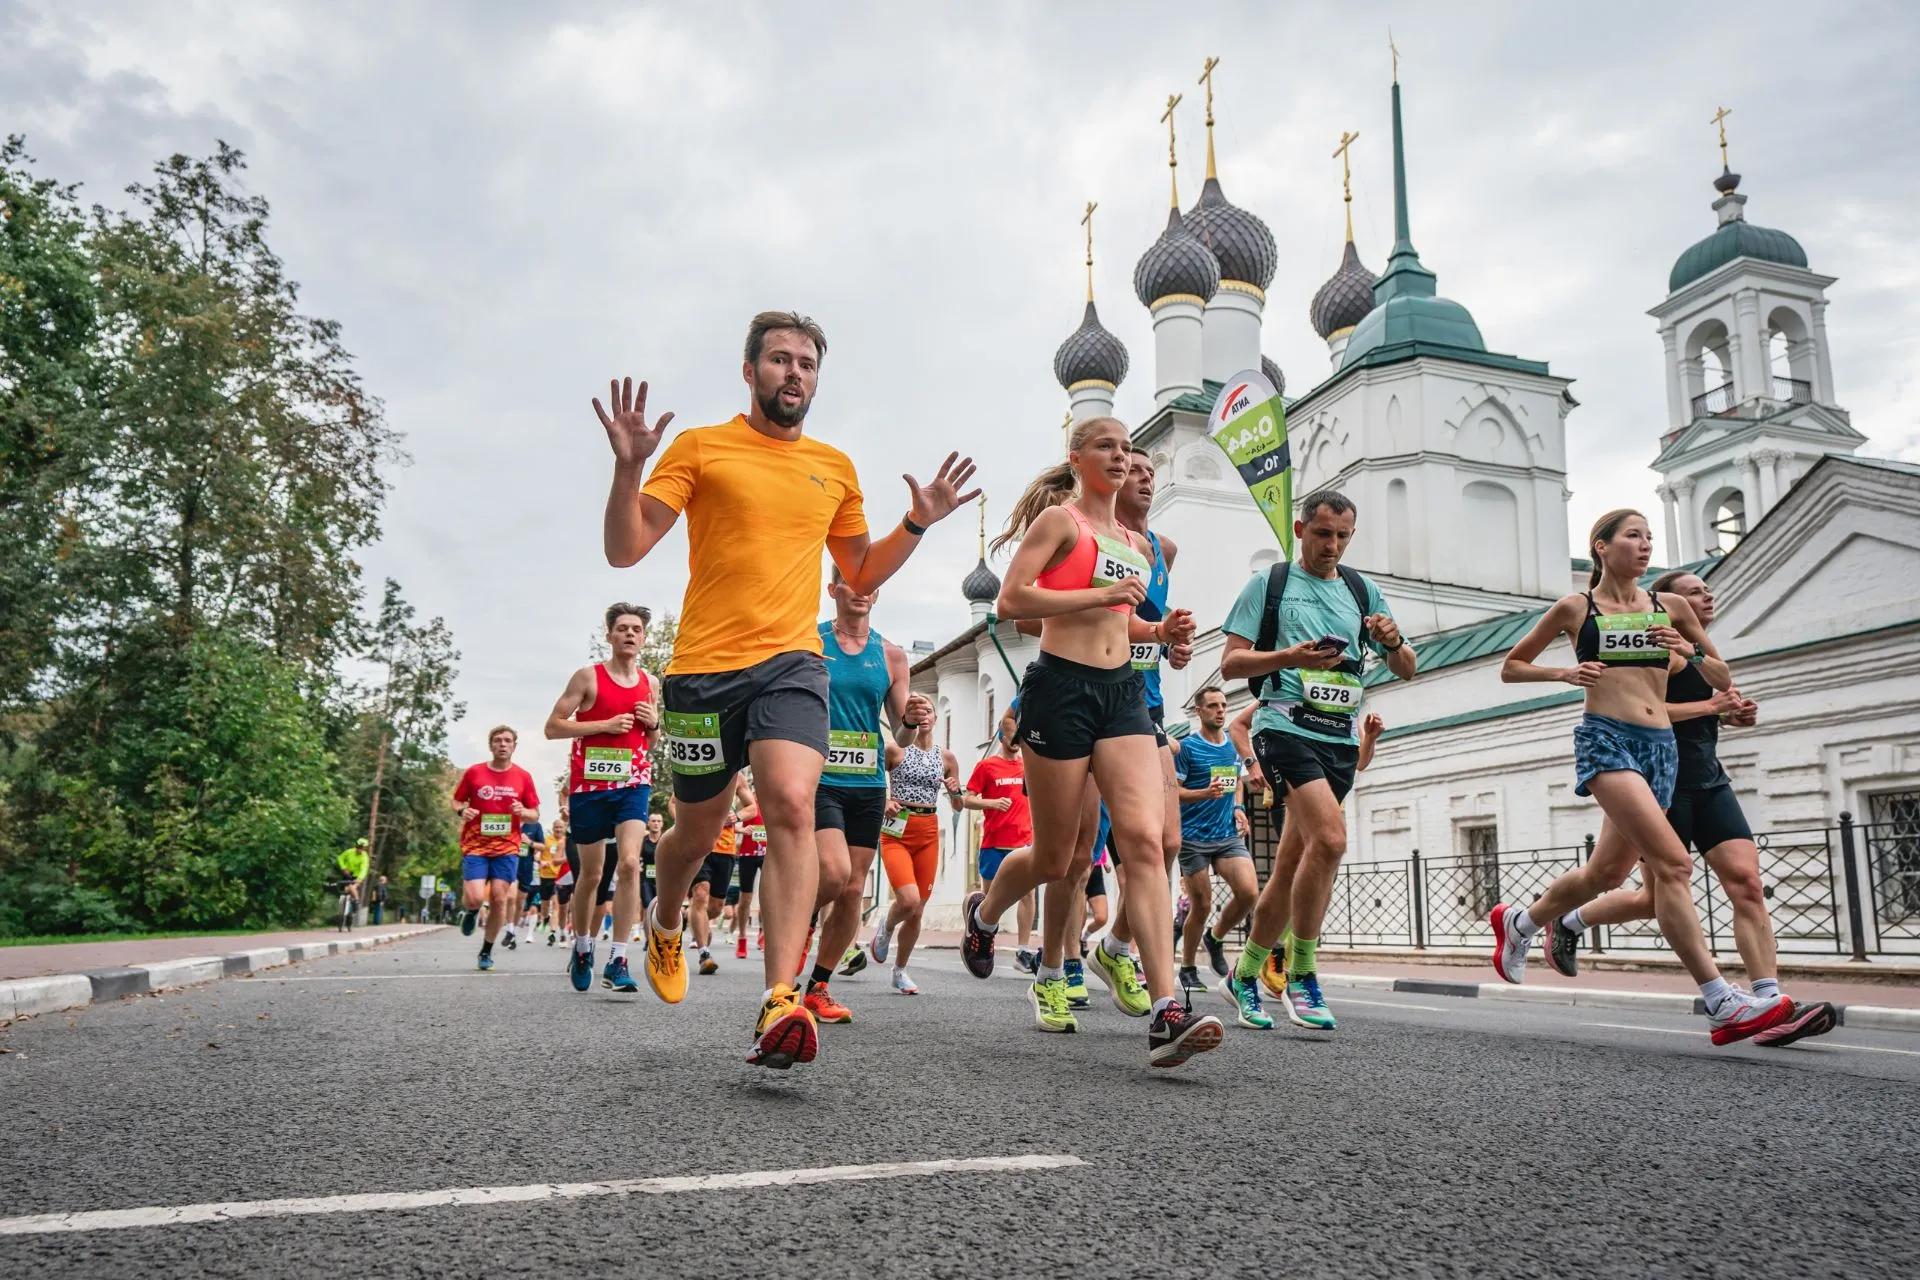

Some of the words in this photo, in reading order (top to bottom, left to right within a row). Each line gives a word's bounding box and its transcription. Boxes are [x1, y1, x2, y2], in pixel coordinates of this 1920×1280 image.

[1310, 686, 1350, 703] 6378
[704, 717, 713, 727] B
[1303, 713, 1346, 729] POWERUP
[671, 741, 716, 762] 5839
[828, 750, 865, 765] 5716
[589, 762, 622, 773] 5676
